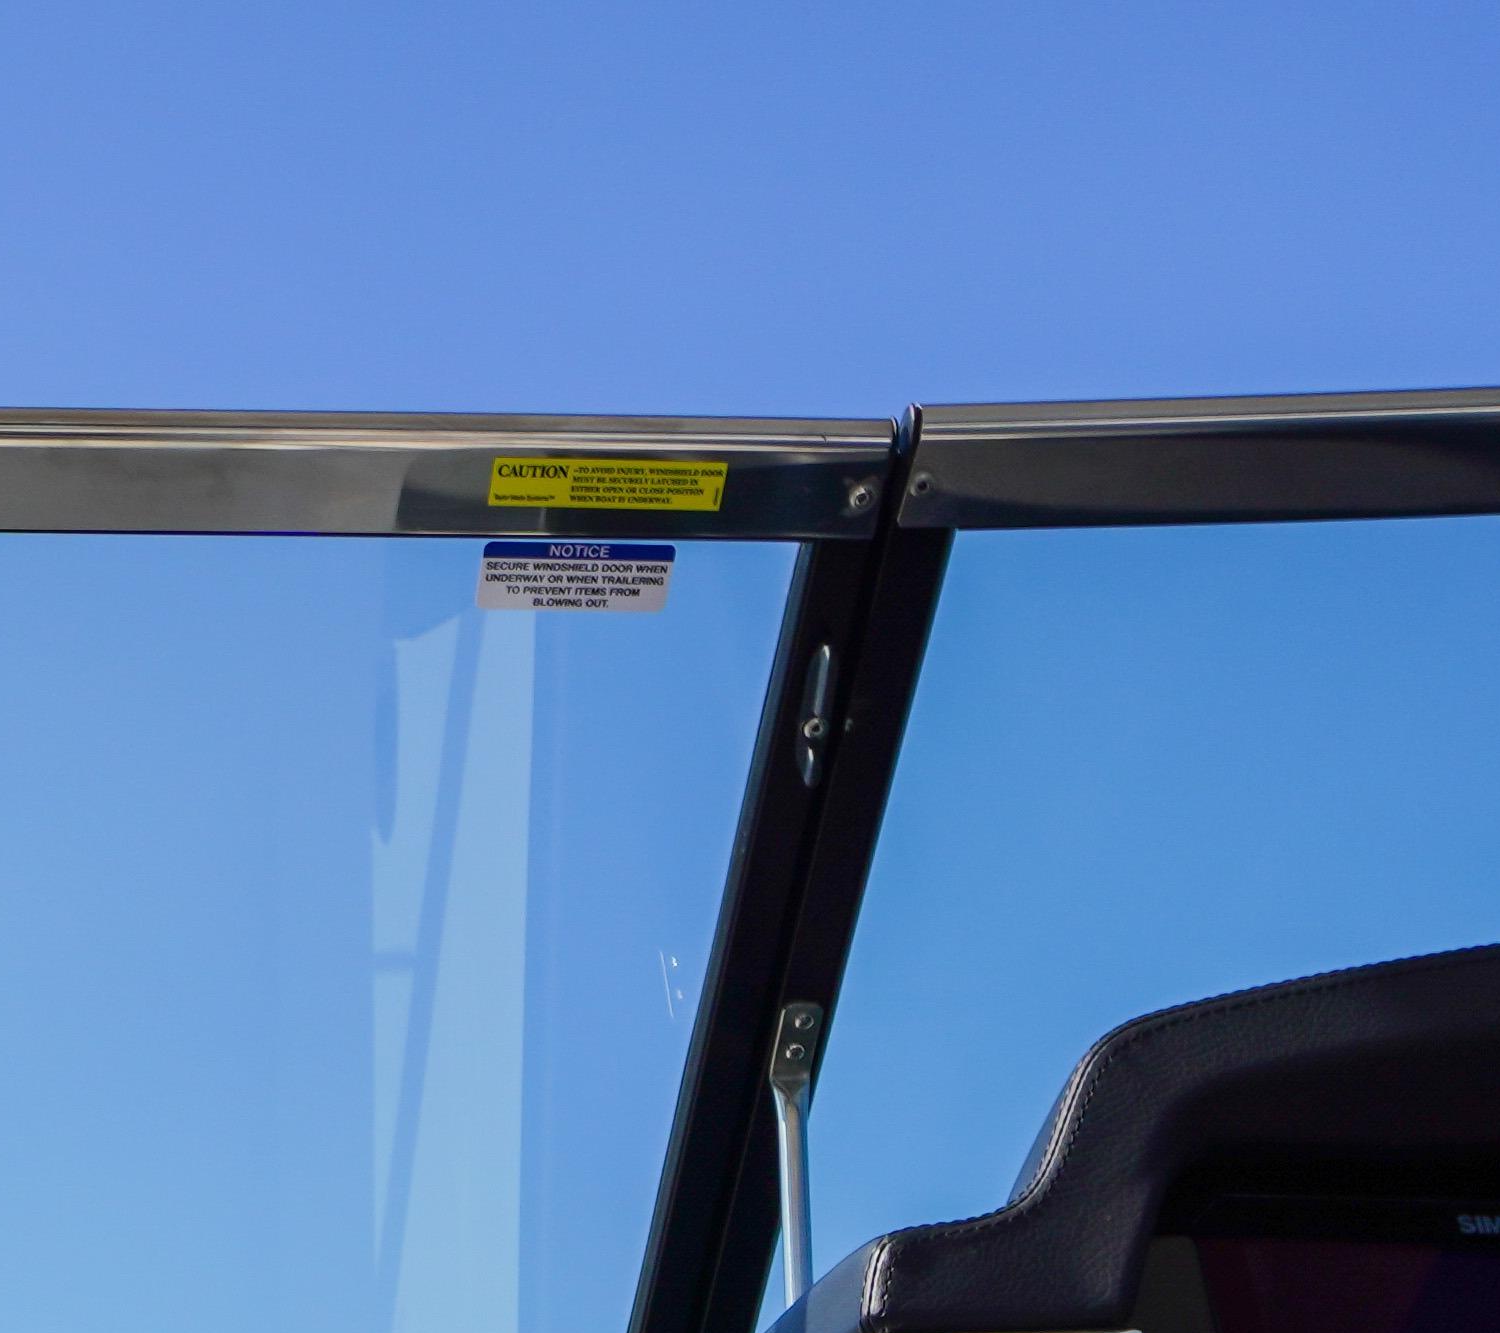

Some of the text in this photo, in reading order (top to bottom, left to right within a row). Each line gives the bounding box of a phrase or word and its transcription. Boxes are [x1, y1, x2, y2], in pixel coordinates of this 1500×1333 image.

[497, 464, 568, 478] CAUTION
[549, 544, 610, 558] NOTICE
[485, 561, 668, 574] SECURE WINDSHIELD DOOR WHEN
[485, 573, 664, 586] UNDERWAY OR WHEN TRAILERING
[507, 585, 640, 597] TO PREVENT ITEMS FROM
[532, 597, 609, 608] BLOWING OUT.
